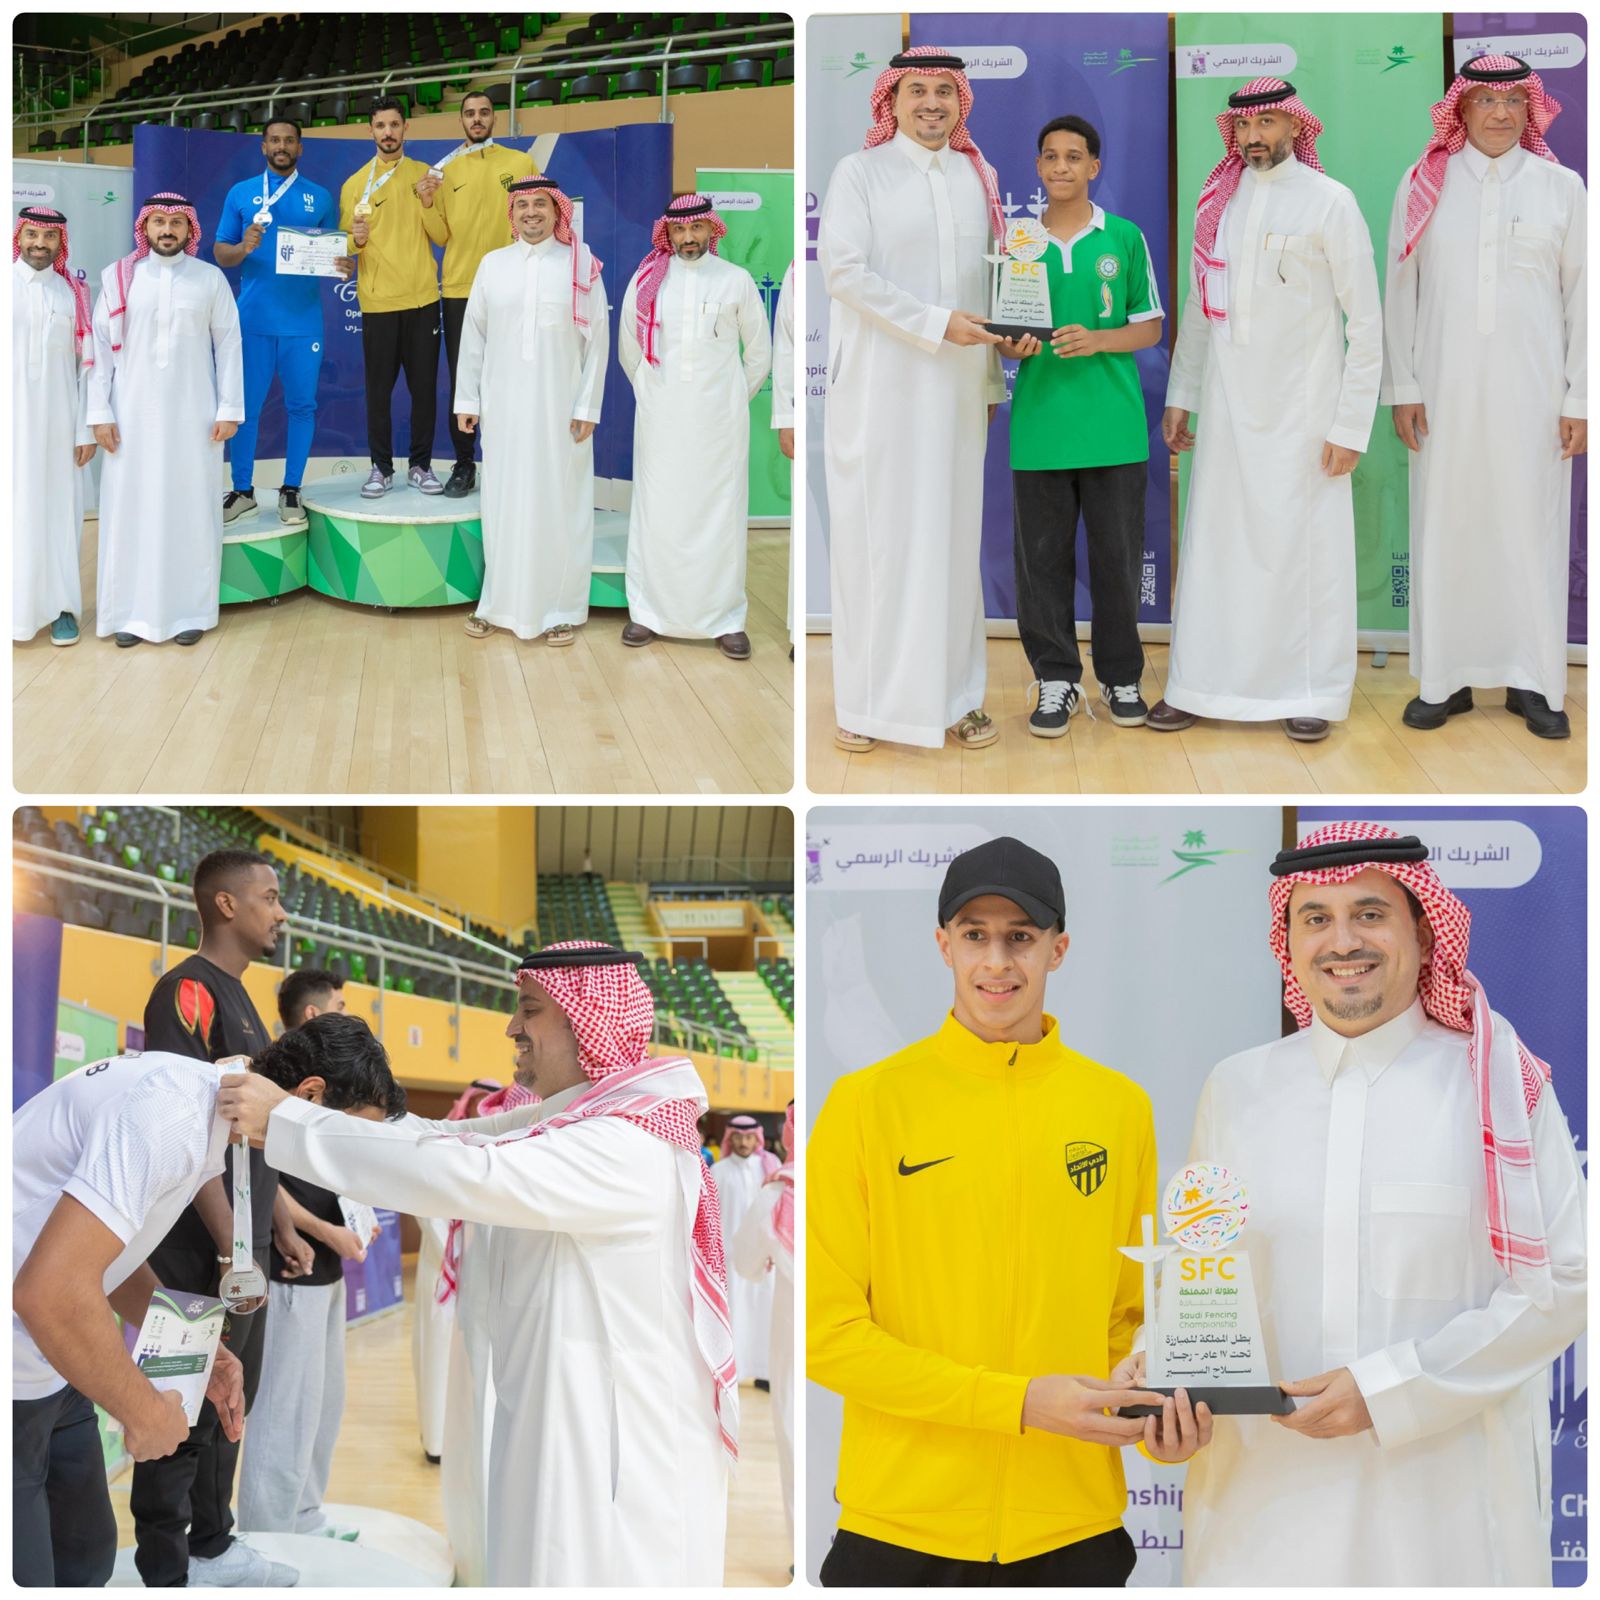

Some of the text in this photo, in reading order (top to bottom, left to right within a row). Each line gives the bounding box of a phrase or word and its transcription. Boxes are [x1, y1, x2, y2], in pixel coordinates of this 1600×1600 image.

[1504, 45, 1569, 58] الشريك الرسم
[1213, 54, 1282, 68] الشريك الرسمي
[1011, 262, 1040, 275] SFC
[345, 308, 362, 319] Ope
[835, 849, 903, 872] الرسمي
[1447, 843, 1510, 867] الشريك
[1180, 1257, 1236, 1281] SFC
[1178, 1287, 1238, 1296] بطولة المملكة
[1179, 1311, 1238, 1320] Saudi Fencing
[1179, 1320, 1238, 1329] Championship
[1165, 1333, 1251, 1347] بطل المملكة للمبارزة
[1165, 1351, 1192, 1361] رجال
[1201, 1350, 1217, 1360] عام
[1229, 1349, 1251, 1359] تحت
[1212, 1366, 1252, 1379] سلاح
